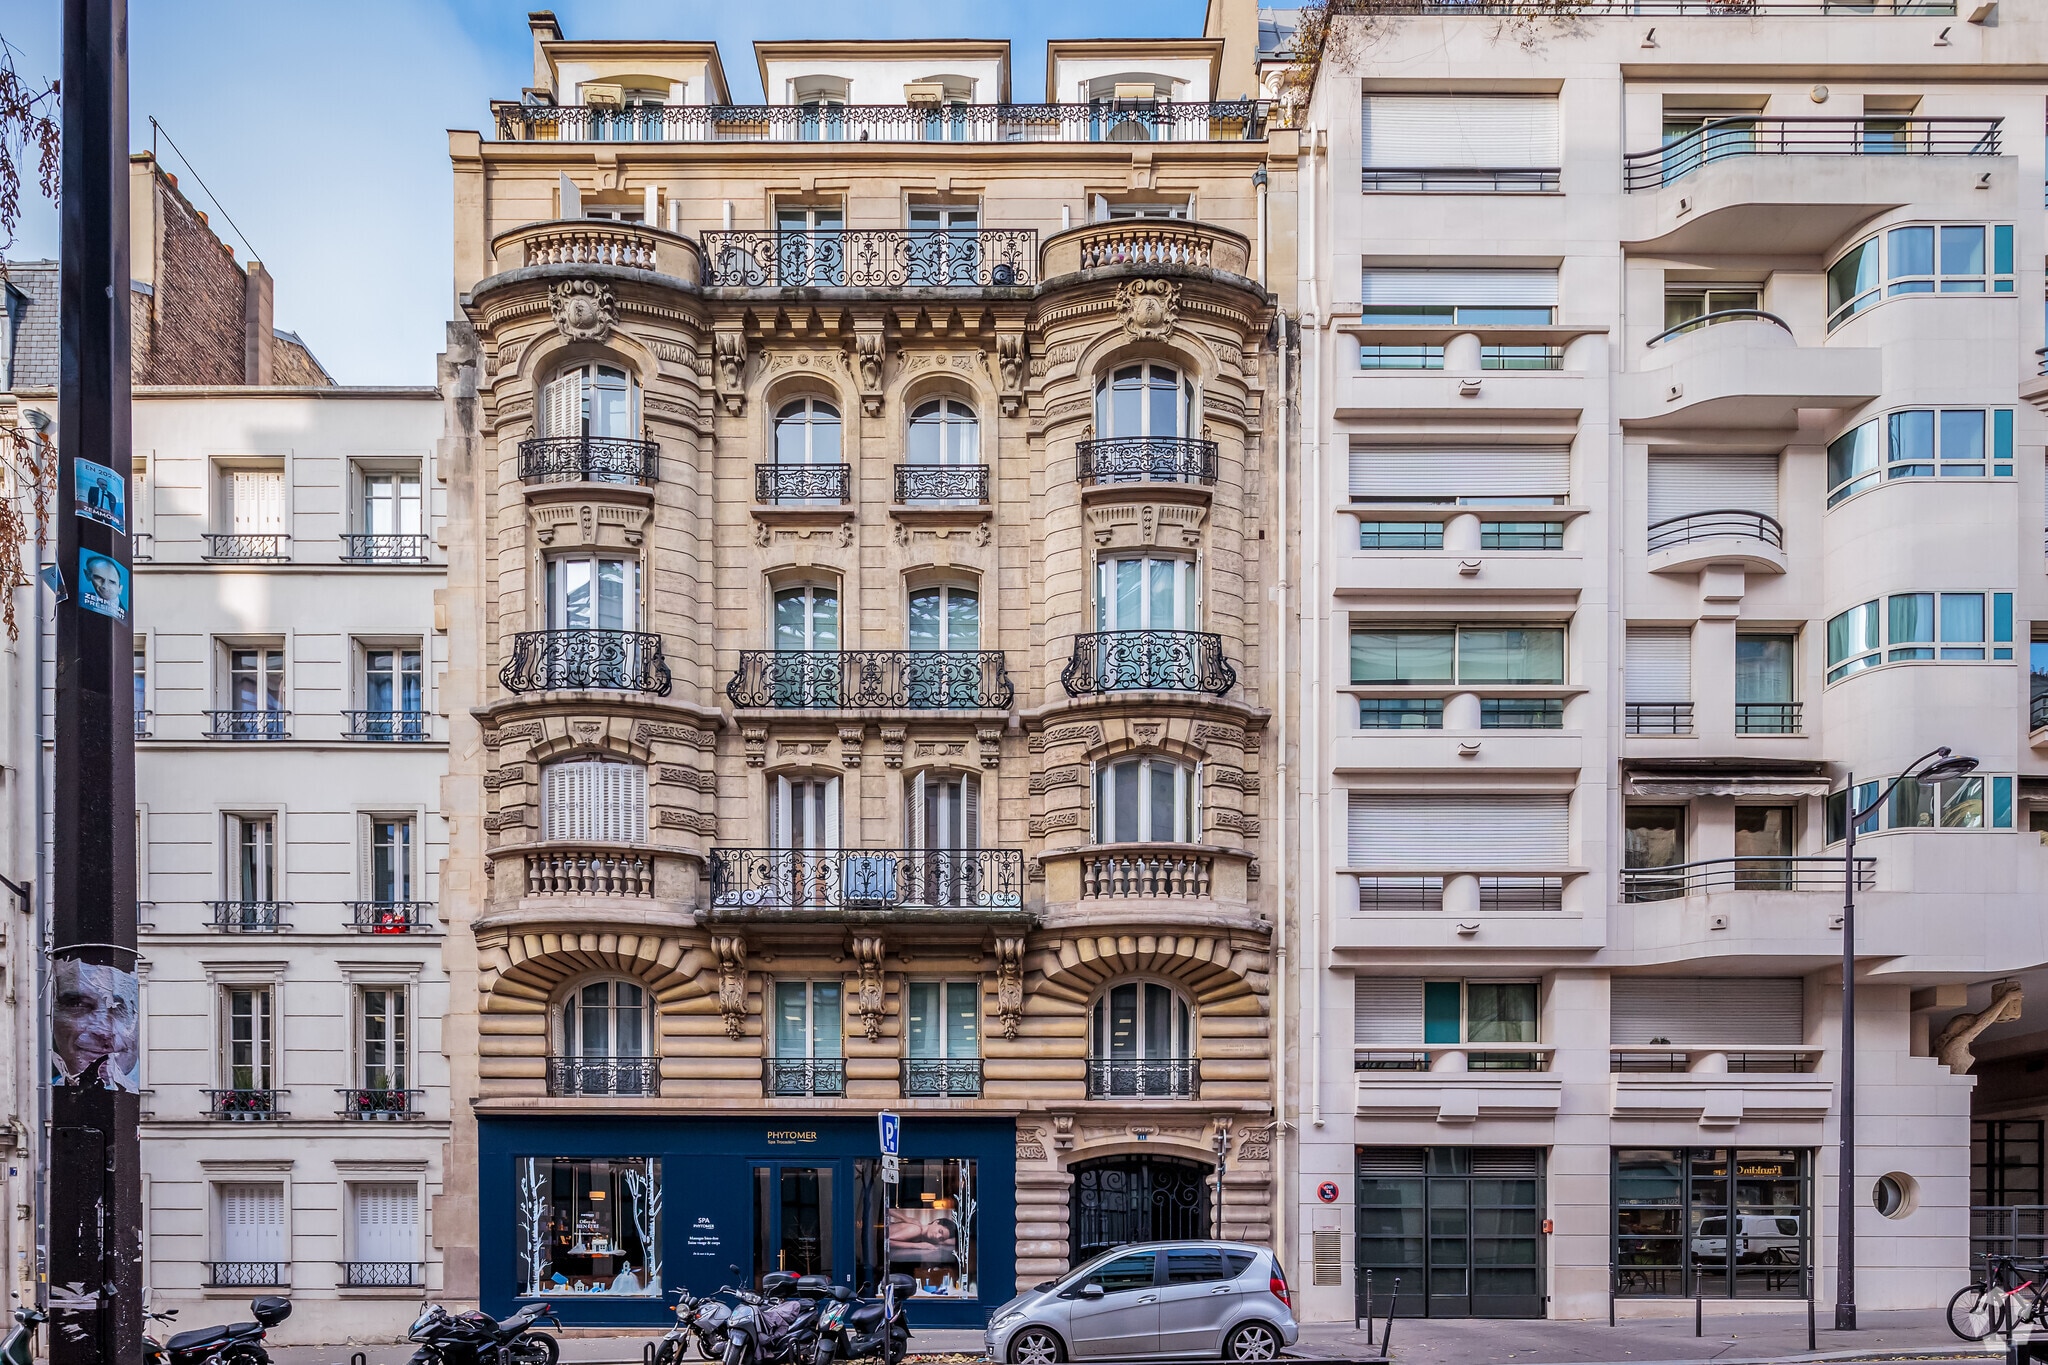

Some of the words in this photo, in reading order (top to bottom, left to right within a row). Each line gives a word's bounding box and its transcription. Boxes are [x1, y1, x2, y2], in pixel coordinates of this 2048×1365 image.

[85, 464, 96, 473] EN
[83, 505, 120, 525] ZEMMOUR
[84, 592, 125, 615] ZEMMOUR
[767, 1131, 817, 1139] PHYTOMER
[885, 1121, 894, 1147] P
